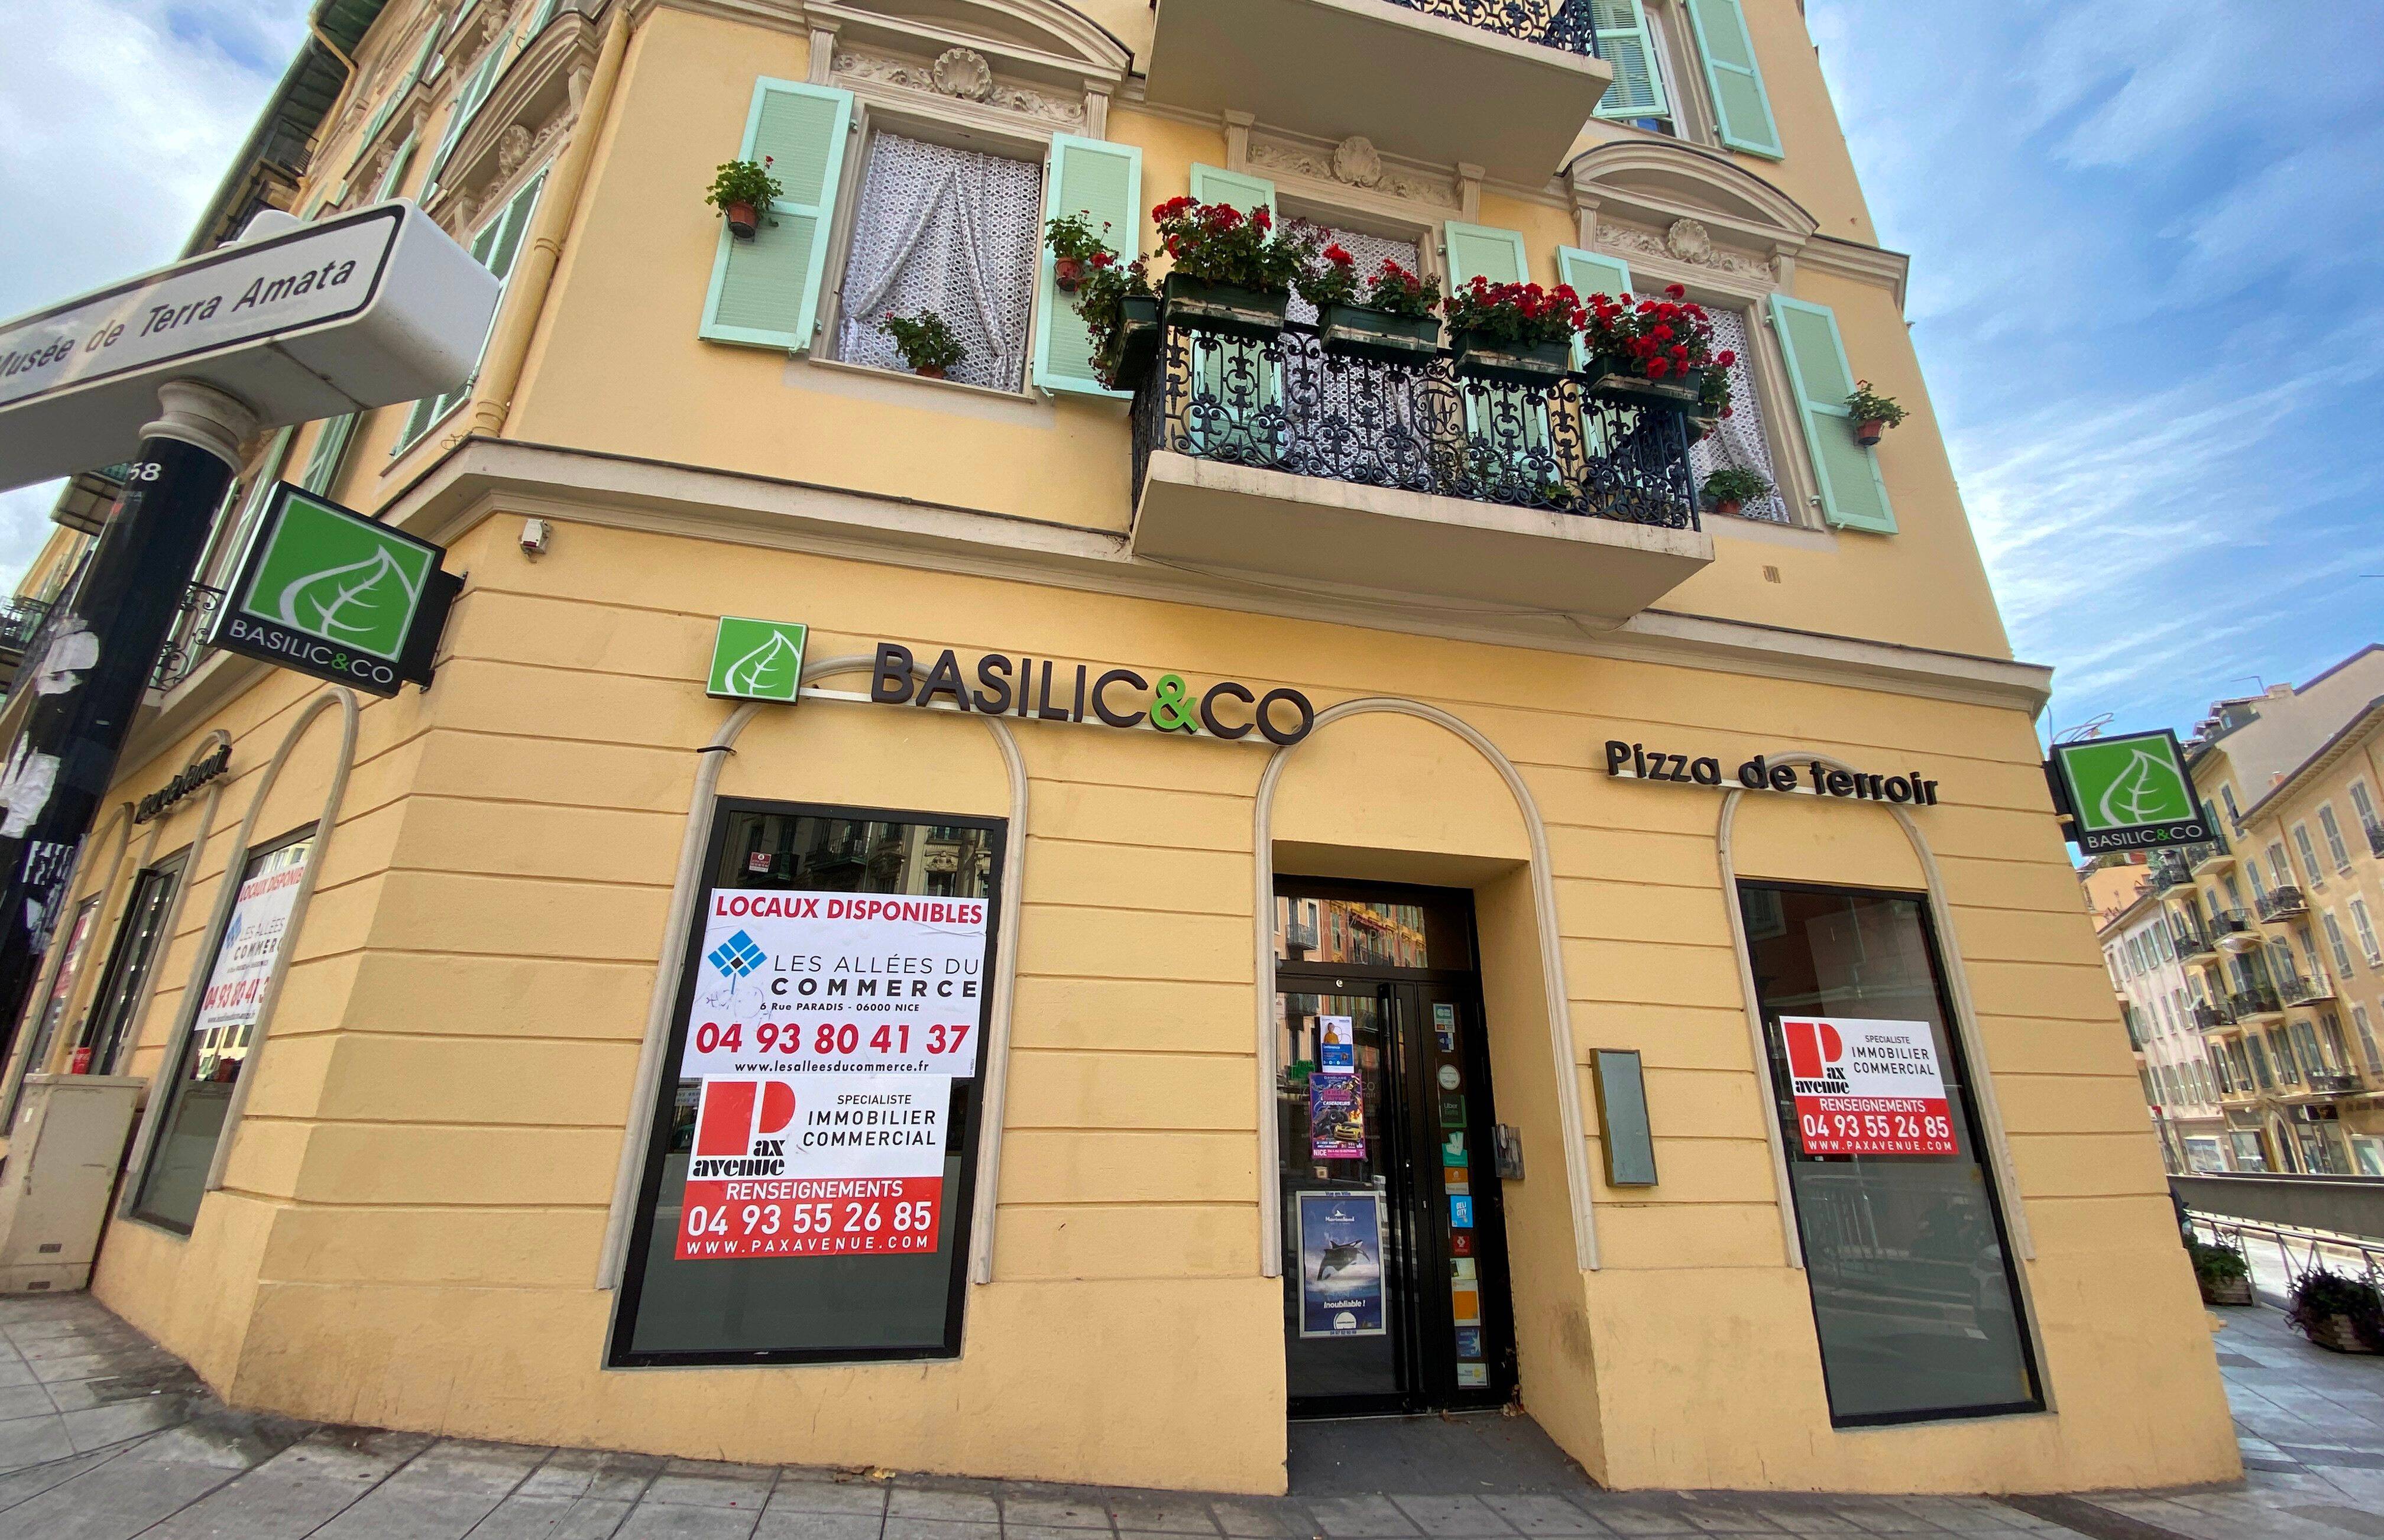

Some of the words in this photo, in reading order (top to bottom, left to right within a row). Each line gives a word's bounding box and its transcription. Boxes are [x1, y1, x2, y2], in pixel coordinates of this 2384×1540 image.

[86, 319, 124, 352] de
[140, 296, 222, 337] Terra
[231, 260, 356, 312] Amata
[229, 619, 393, 683] BASILIC&CO
[872, 642, 1314, 745] BASILIC&CO
[1605, 740, 1723, 786] Pizza
[1738, 755, 1797, 792] de
[1809, 761, 1938, 806] terroir
[2087, 825, 2203, 849] BASILIC&CO
[716, 896, 820, 918] LOCAUX
[827, 899, 983, 924] DISPONIBLES
[774, 955, 821, 971] LES
[834, 954, 933, 974] ALLÉES
[945, 958, 979, 974] DU
[771, 977, 977, 998] COMMERCE
[772, 1003, 792, 1011] Rue
[796, 1003, 844, 1011] PARADIS
[856, 1003, 891, 1012] 06000
[895, 1004, 919, 1012] NICE
[696, 1022, 742, 1054] 04
[756, 1023, 801, 1054] 93
[814, 1023, 859, 1054] 80
[870, 1024, 909, 1054] 41
[926, 1024, 971, 1054] 37
[1865, 1035, 1910, 1045] SPECIALISTE
[1851, 1046, 1929, 1060] IMMOBILIER
[735, 1059, 929, 1072] www.lesalleesducommerce.fr
[1854, 1062, 1935, 1075] COMMERCIAL
[1795, 1079, 1849, 1094] avenue
[837, 1094, 912, 1105] SPECIALISTE
[1819, 1098, 1926, 1114] RENSEIGNEMENTS
[808, 1110, 936, 1126] IMMOBILIER
[1803, 1114, 1829, 1137] 04
[1834, 1114, 1860, 1138] 93
[1864, 1115, 1890, 1138] 55
[1894, 1116, 1920, 1138] 26
[1924, 1116, 1949, 1139] 85
[803, 1130, 936, 1147] COMMERCIAL
[1808, 1140, 1952, 1151] WWW.PAXAVENUE.COM
[692, 1158, 785, 1177] avenue
[725, 1180, 903, 1201] RENSEIGNEMENTS
[687, 1205, 728, 1236] 04
[742, 1204, 781, 1235] 93
[793, 1203, 833, 1234] 55
[843, 1202, 882, 1233] 26
[893, 1201, 932, 1231] 85
[686, 1235, 928, 1255] WWW.PAXAVENUE.COM
[1324, 1299, 1362, 1309] Inoubliable
